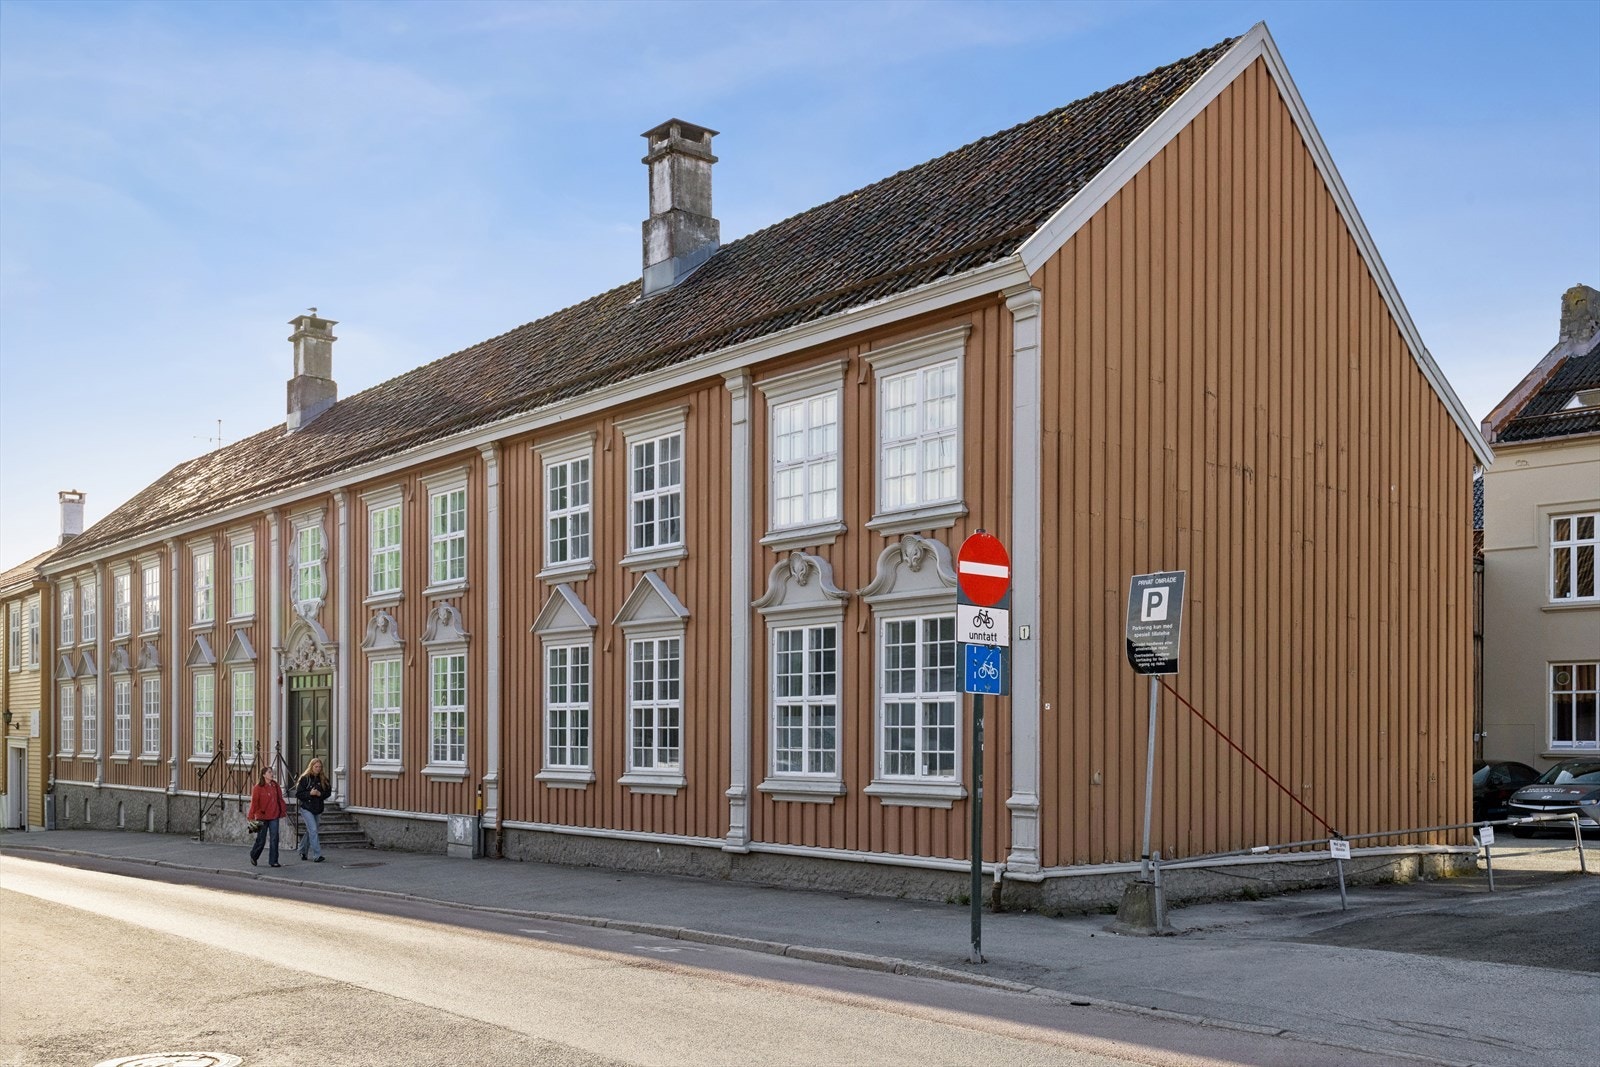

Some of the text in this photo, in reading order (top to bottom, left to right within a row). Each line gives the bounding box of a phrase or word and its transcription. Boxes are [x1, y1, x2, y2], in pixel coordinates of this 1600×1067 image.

[1155, 576, 1177, 584] OMRÅDE
[1146, 591, 1163, 618] P
[969, 632, 998, 642] unntatt
[1022, 628, 1026, 638] 1
